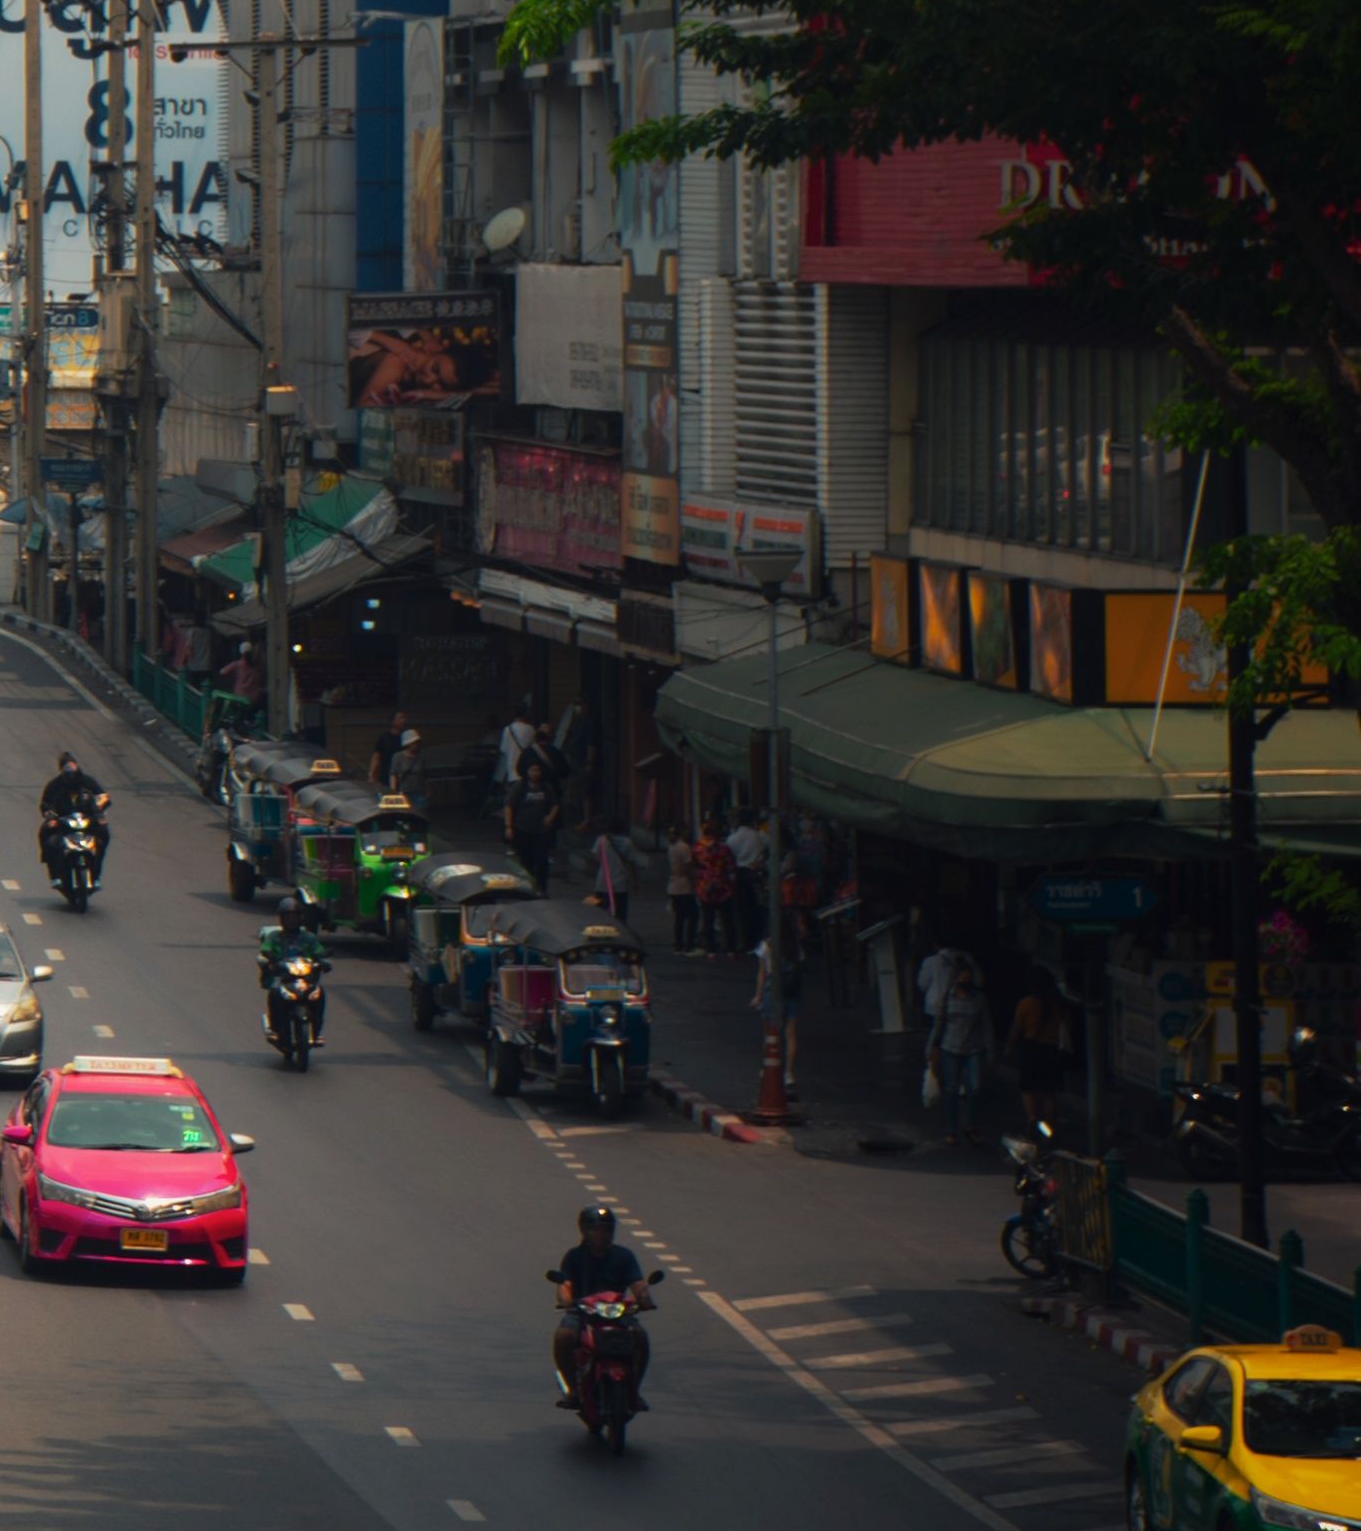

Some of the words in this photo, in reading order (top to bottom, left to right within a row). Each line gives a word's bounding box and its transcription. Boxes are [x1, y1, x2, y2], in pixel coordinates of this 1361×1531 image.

[1000, 159, 1277, 212] DRN
[1132, 886, 1143, 908] 1
[1300, 1332, 1327, 1346] TAXI
